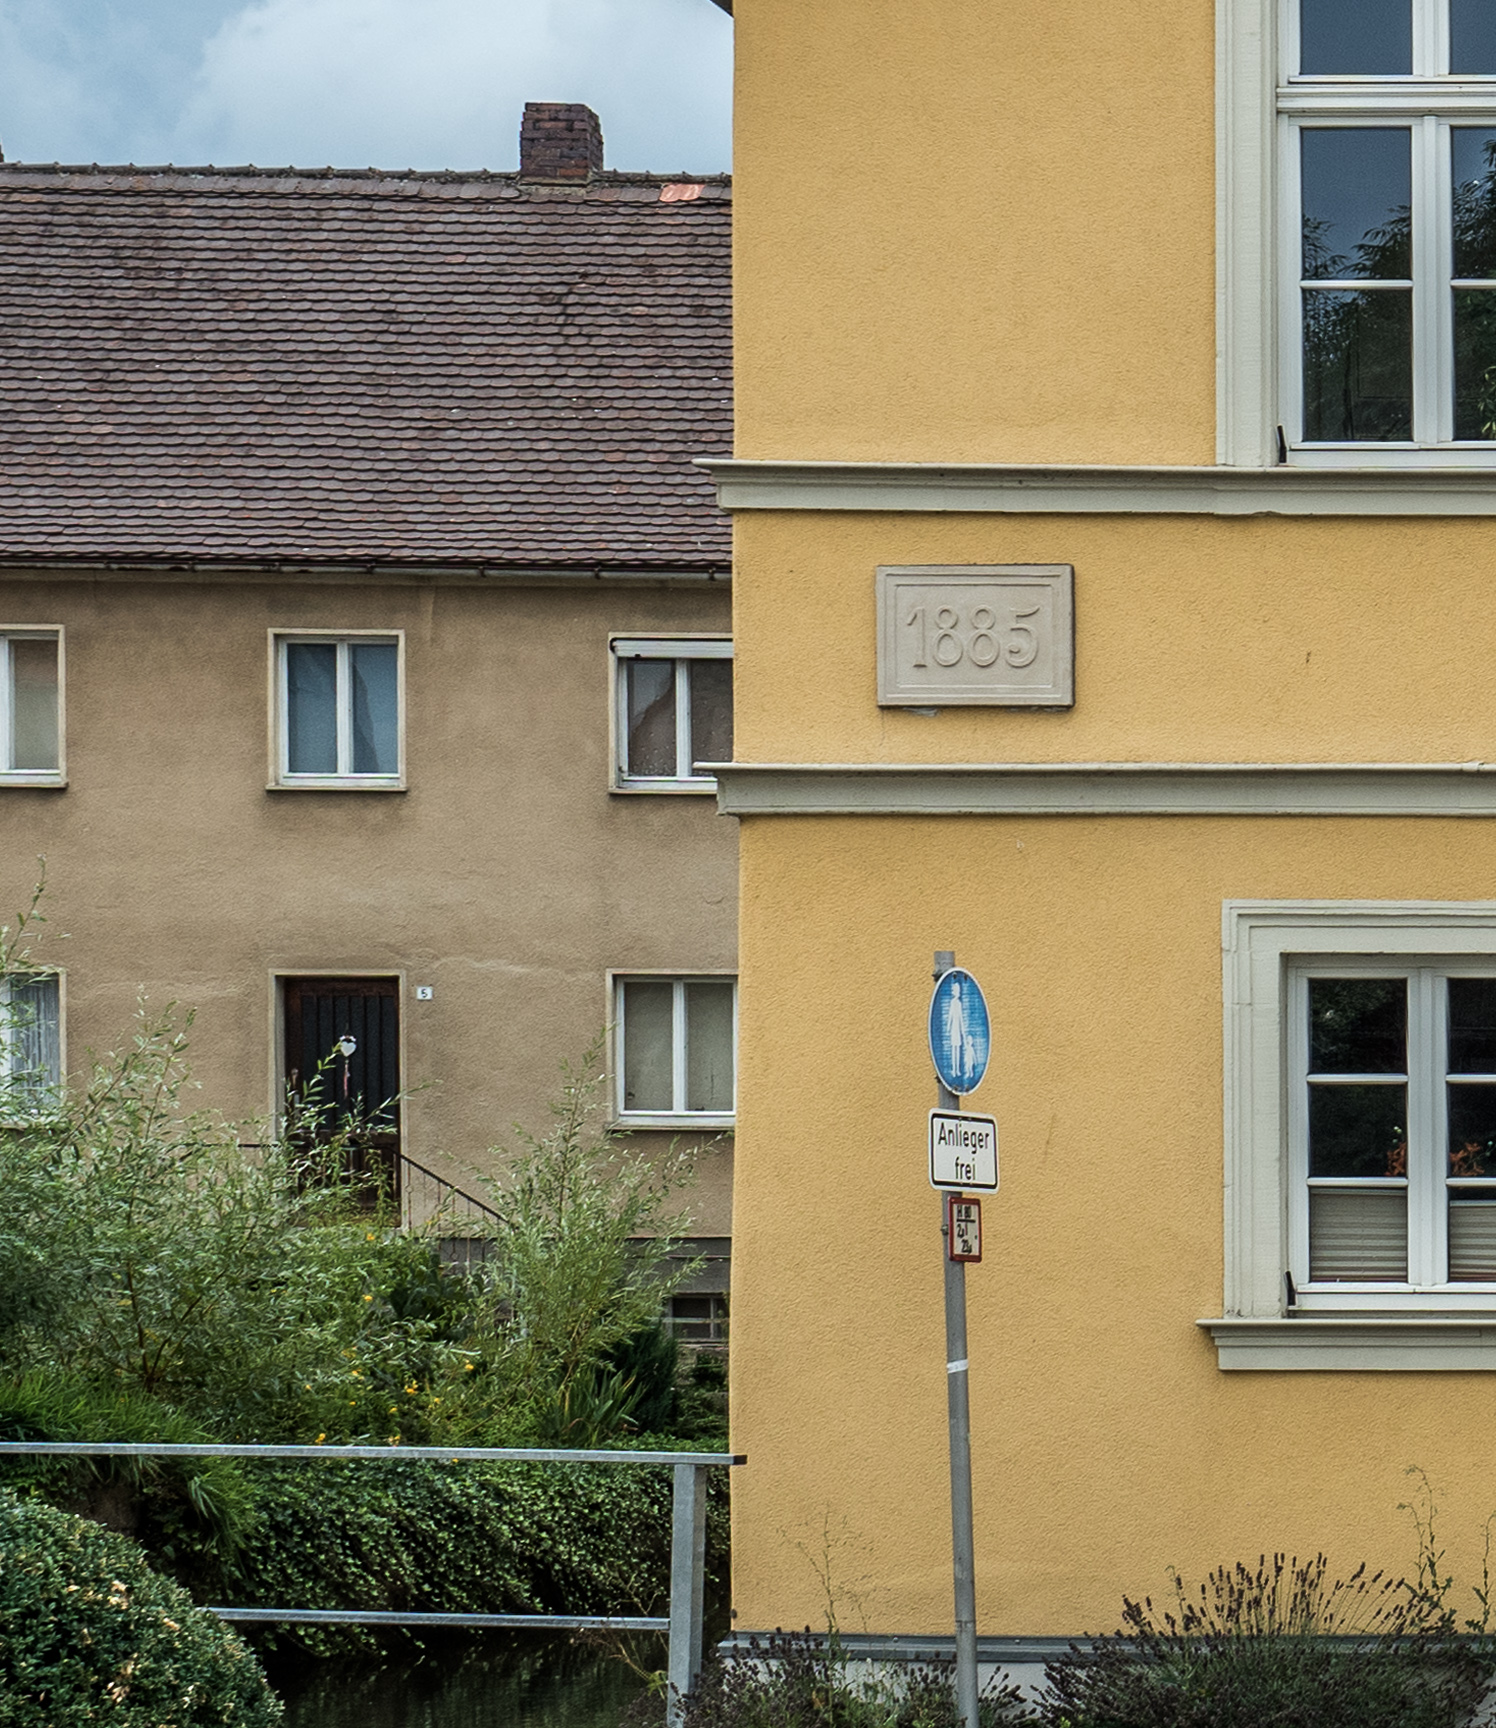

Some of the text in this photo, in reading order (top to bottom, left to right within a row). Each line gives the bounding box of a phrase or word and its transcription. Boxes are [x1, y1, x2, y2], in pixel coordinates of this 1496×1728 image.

[906, 604, 1041, 669] 1885
[421, 988, 429, 999] 5
[938, 1122, 989, 1154] Anlieger
[955, 1156, 976, 1181] frei
